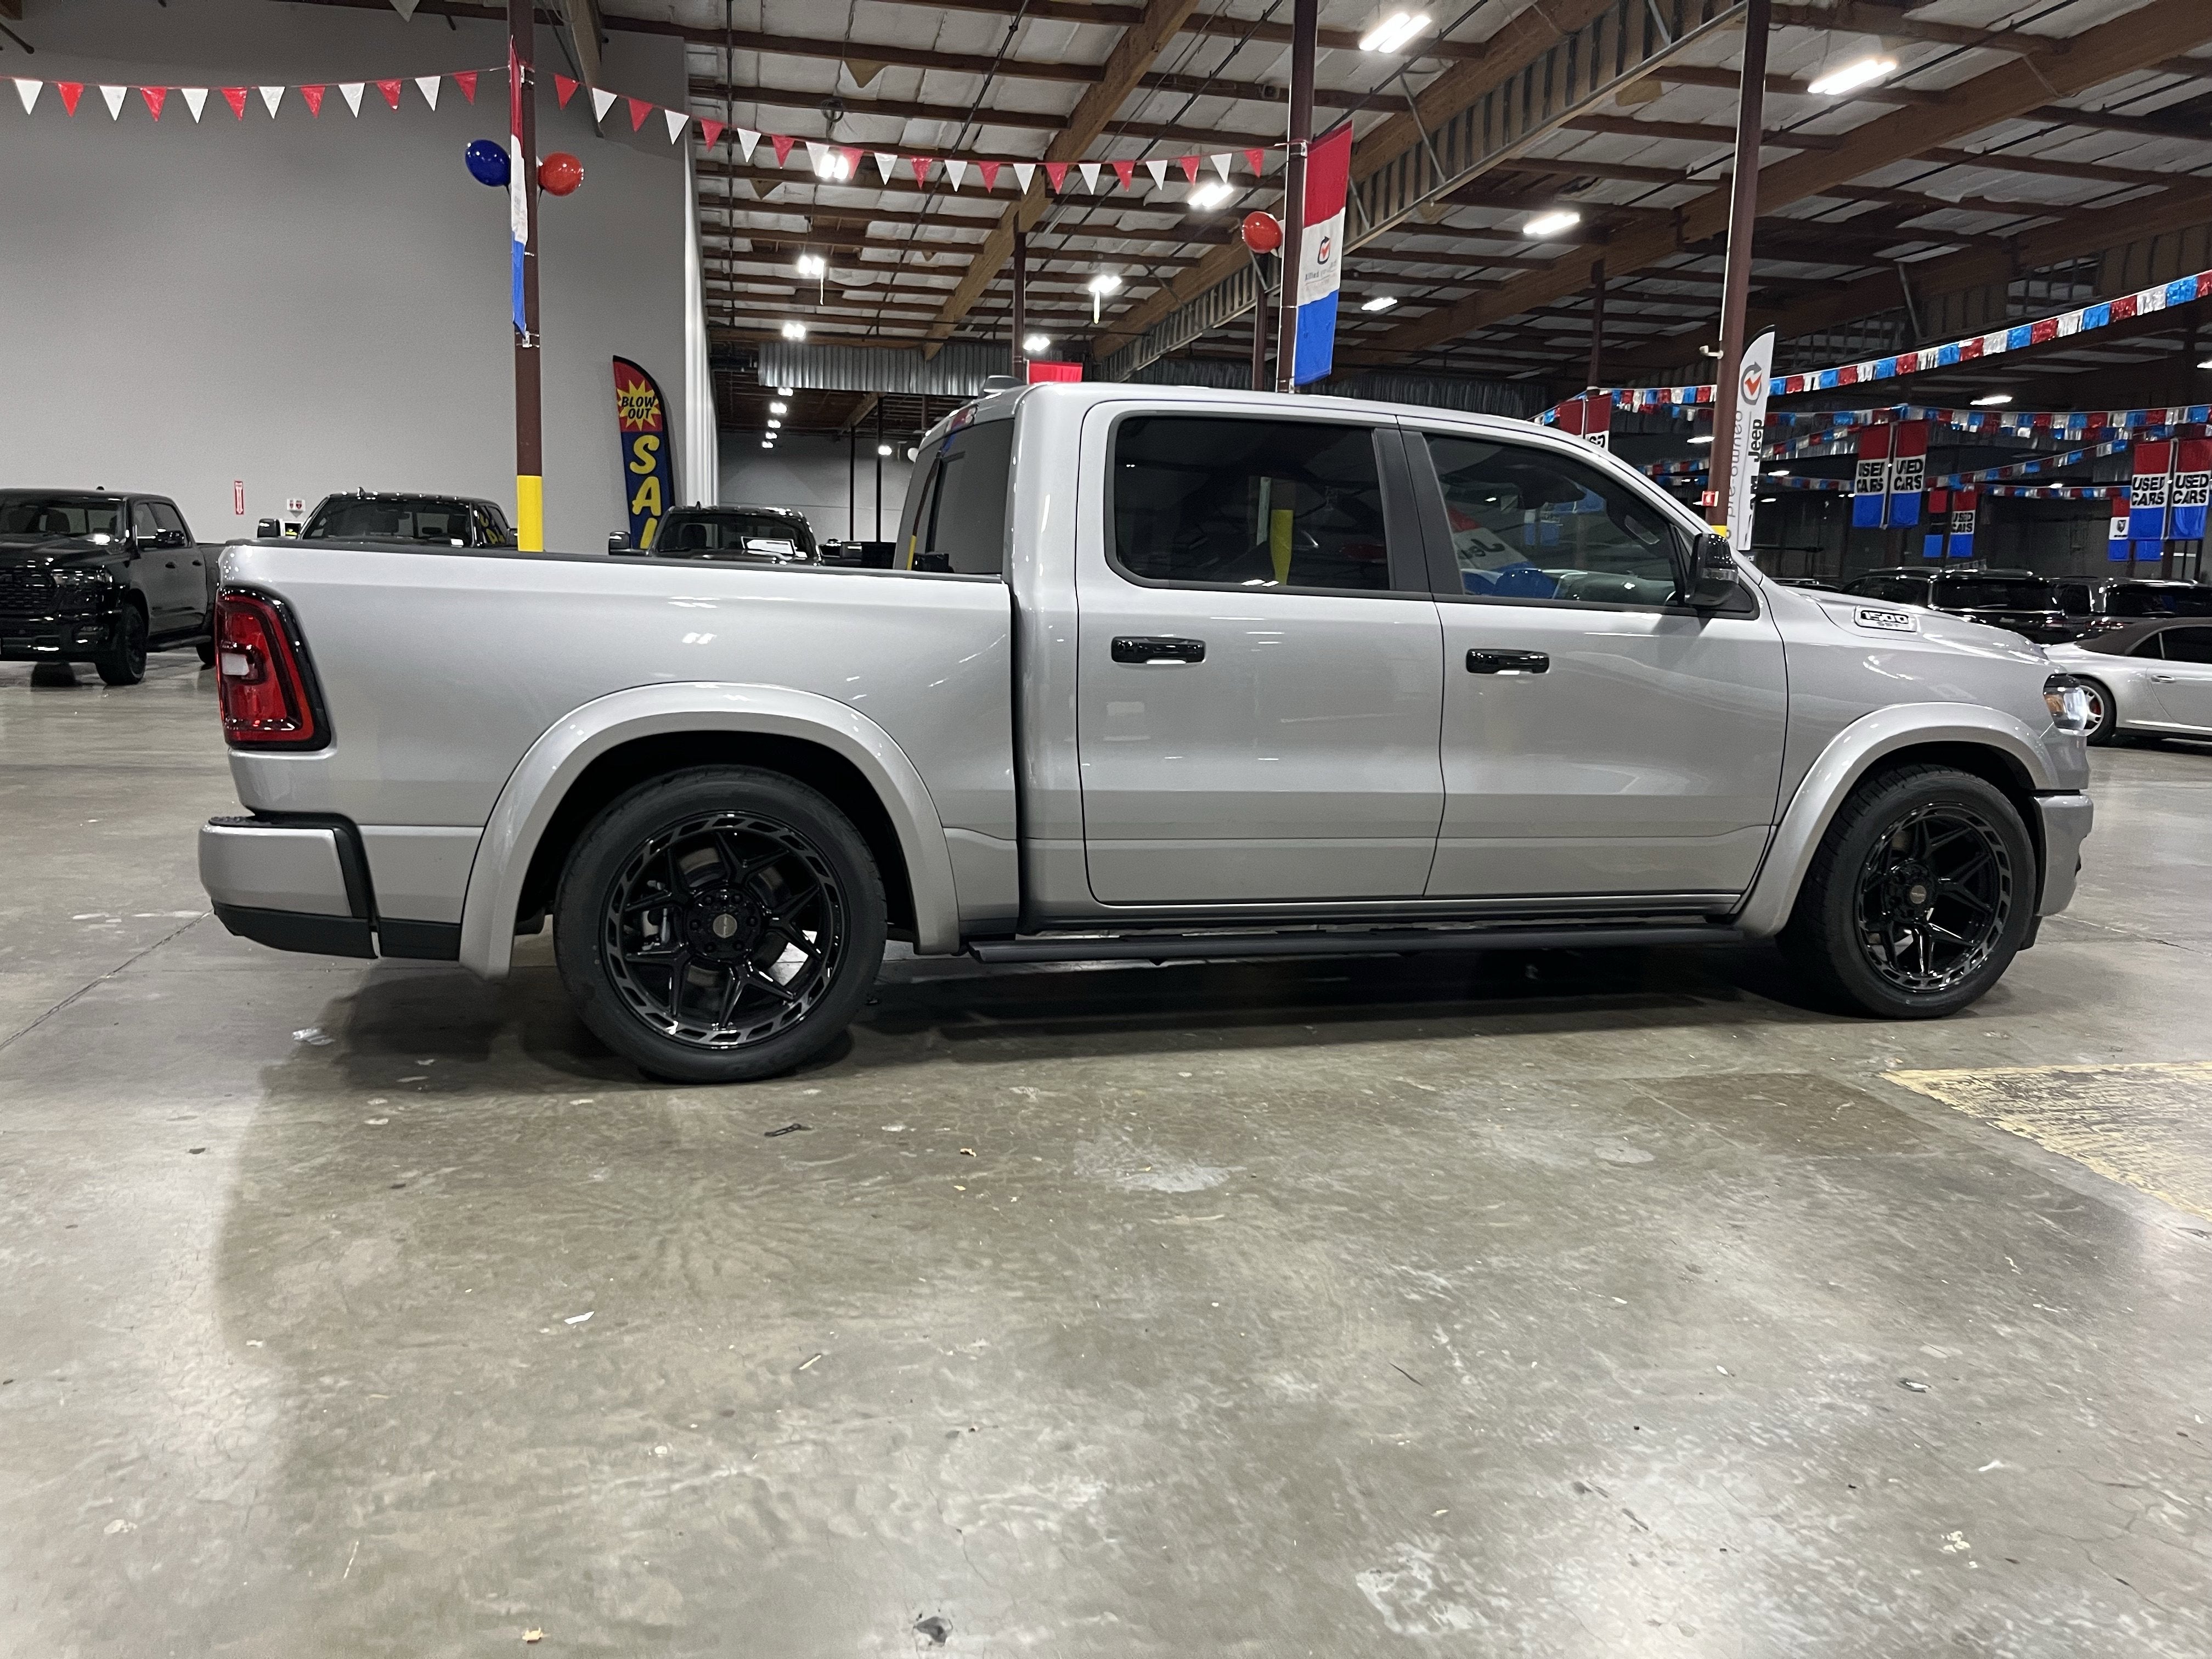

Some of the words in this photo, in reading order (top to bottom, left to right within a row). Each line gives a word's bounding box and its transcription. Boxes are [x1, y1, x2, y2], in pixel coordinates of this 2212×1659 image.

[622, 396, 656, 407] BLOW
[628, 408, 651, 419] OUT
[1748, 419, 1764, 462] Jeep
[1859, 462, 1885, 477] SE
[1897, 459, 1923, 475] UED
[2175, 473, 2209, 489] USED
[2131, 491, 2164, 506] CARS
[2172, 489, 2207, 504] CARS
